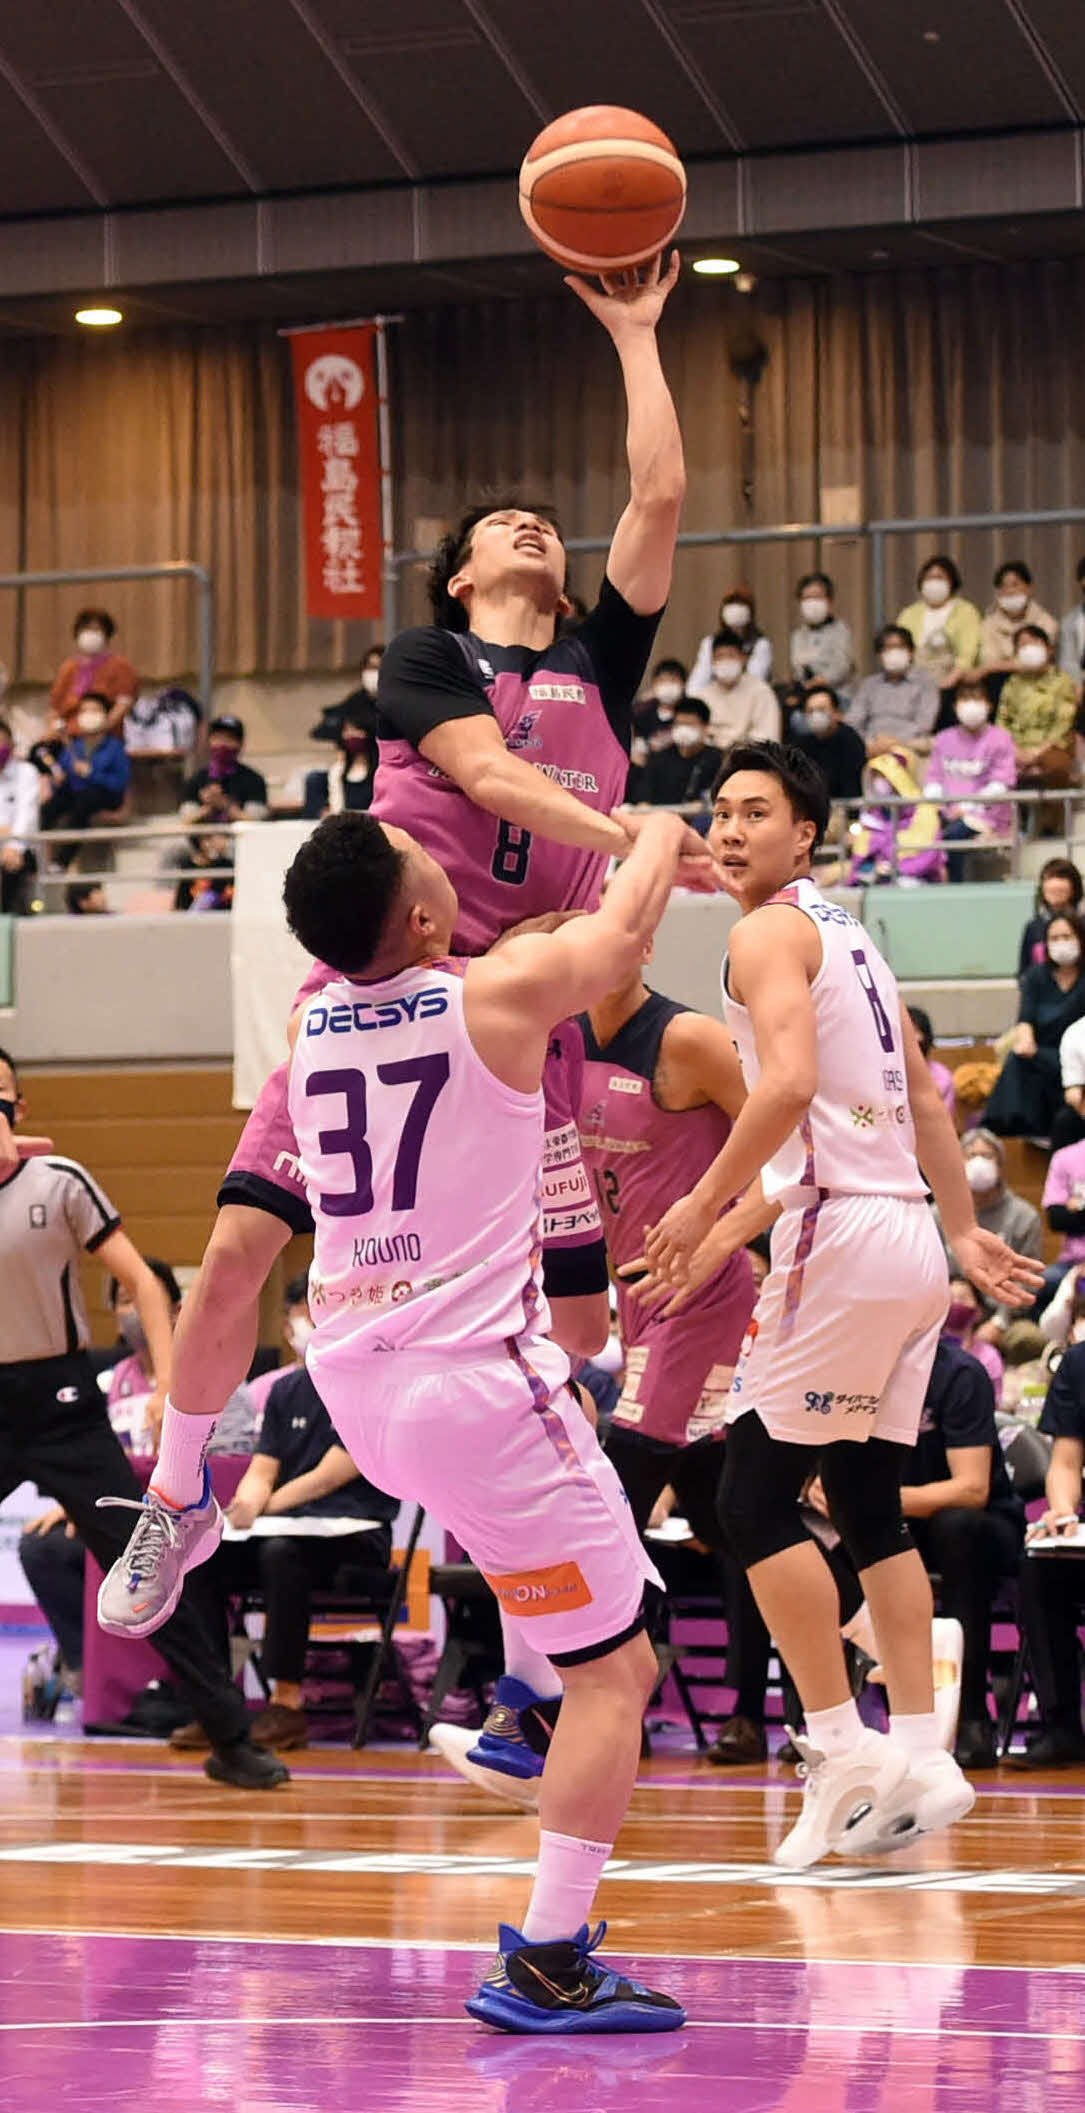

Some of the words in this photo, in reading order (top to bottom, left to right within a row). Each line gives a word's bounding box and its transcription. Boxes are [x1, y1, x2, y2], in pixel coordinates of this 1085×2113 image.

[490, 816, 534, 887] 8
[306, 987, 449, 1037] DECSYS
[850, 949, 895, 1054] 8
[306, 1052, 450, 1217] 37
